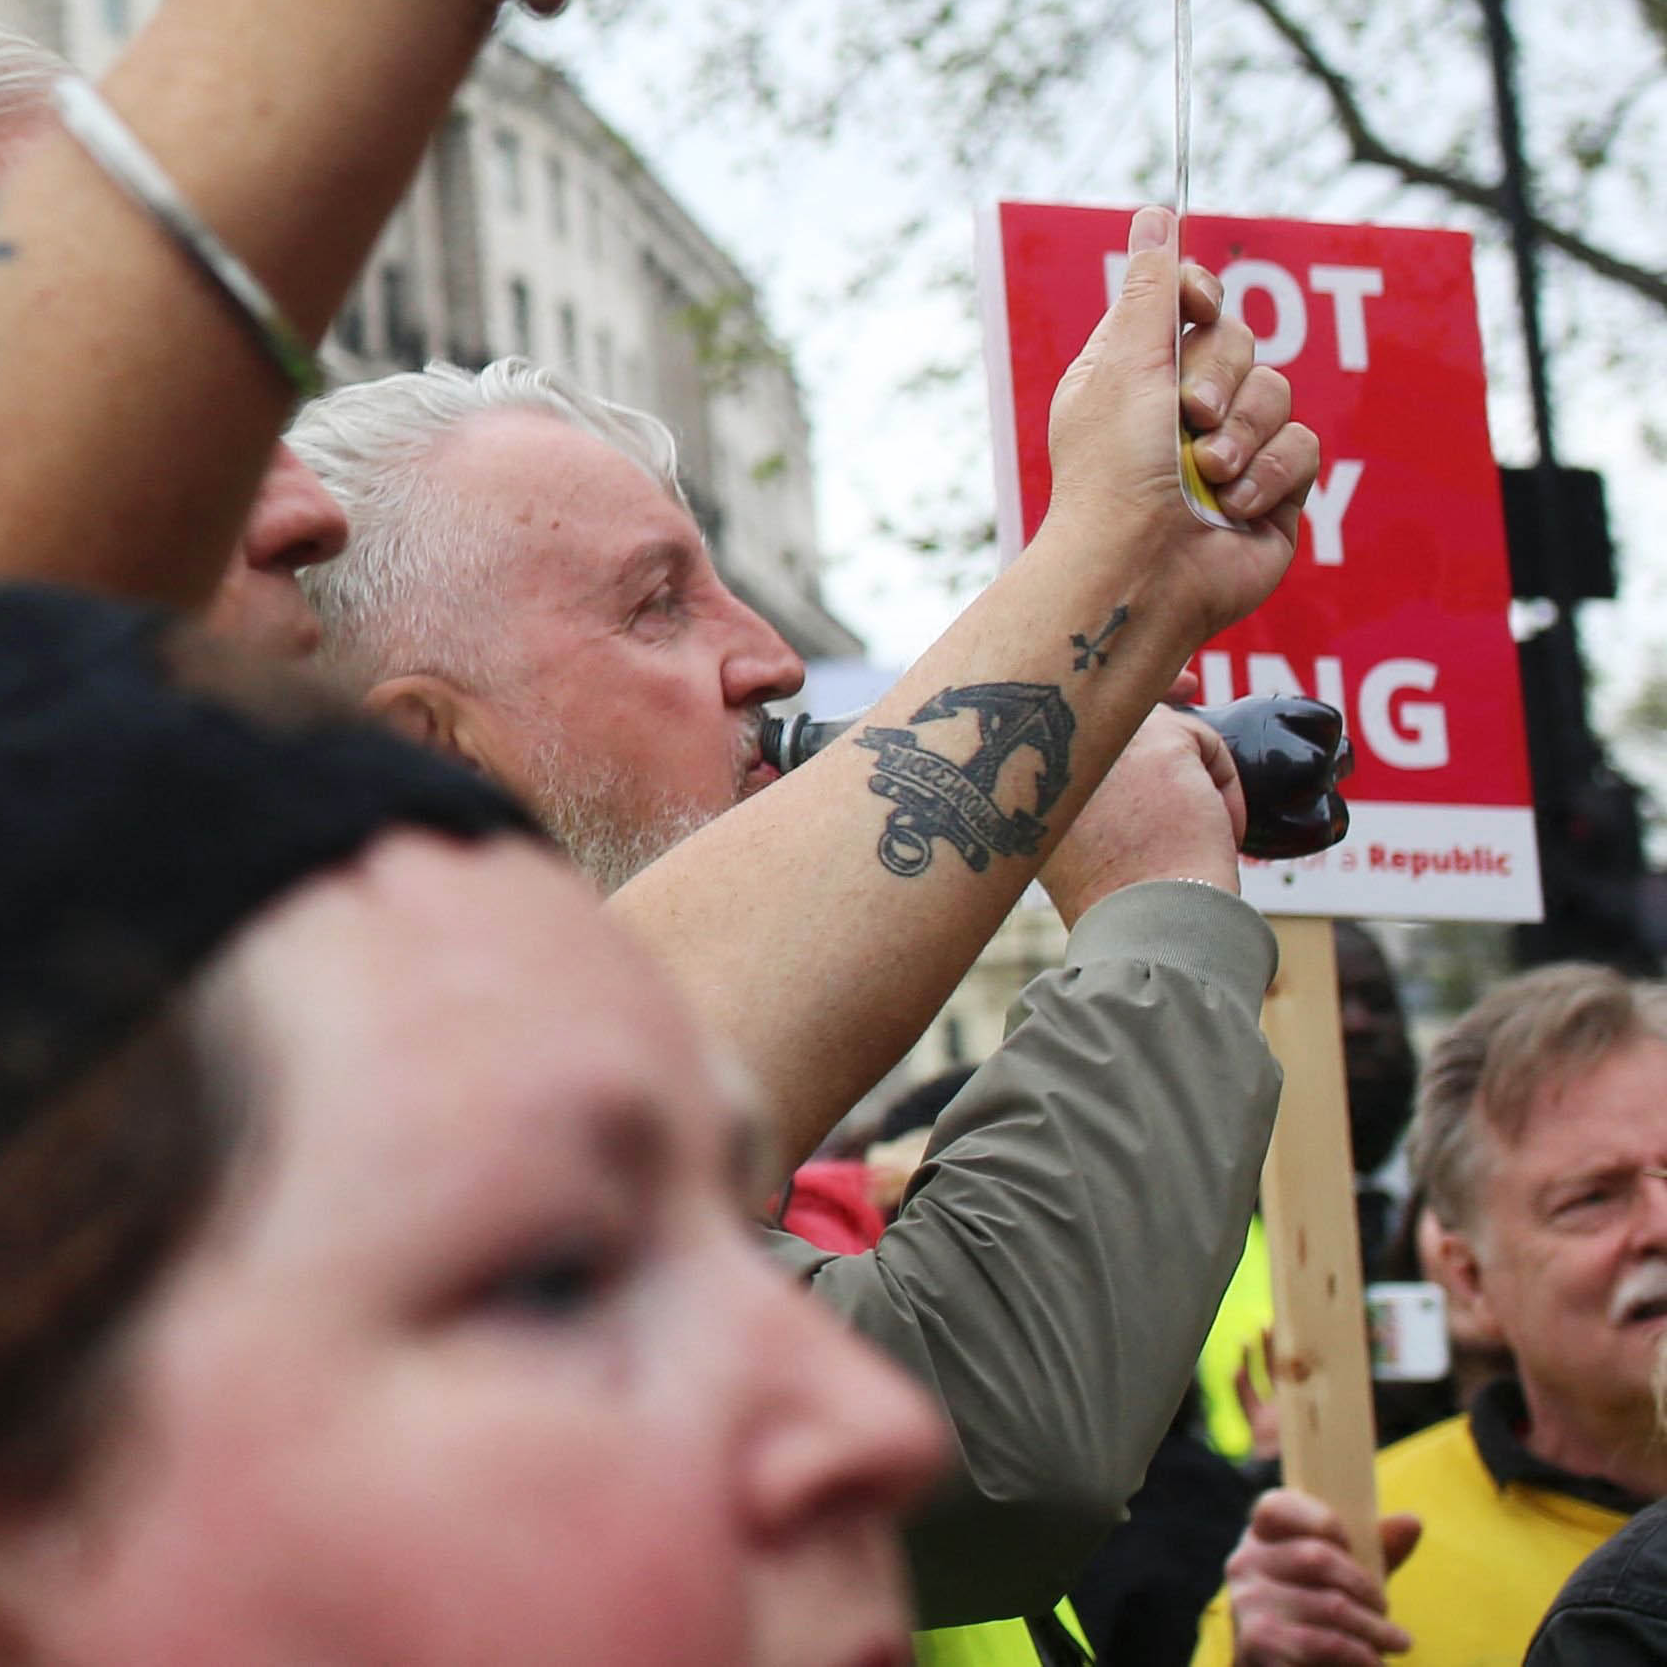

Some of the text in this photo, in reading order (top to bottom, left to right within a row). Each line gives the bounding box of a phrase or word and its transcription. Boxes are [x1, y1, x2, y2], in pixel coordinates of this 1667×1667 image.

[1103, 250, 1385, 374] OT
[1301, 459, 1365, 567] Y
[1199, 649, 1451, 771] ING
[1368, 843, 1512, 880] Republic
